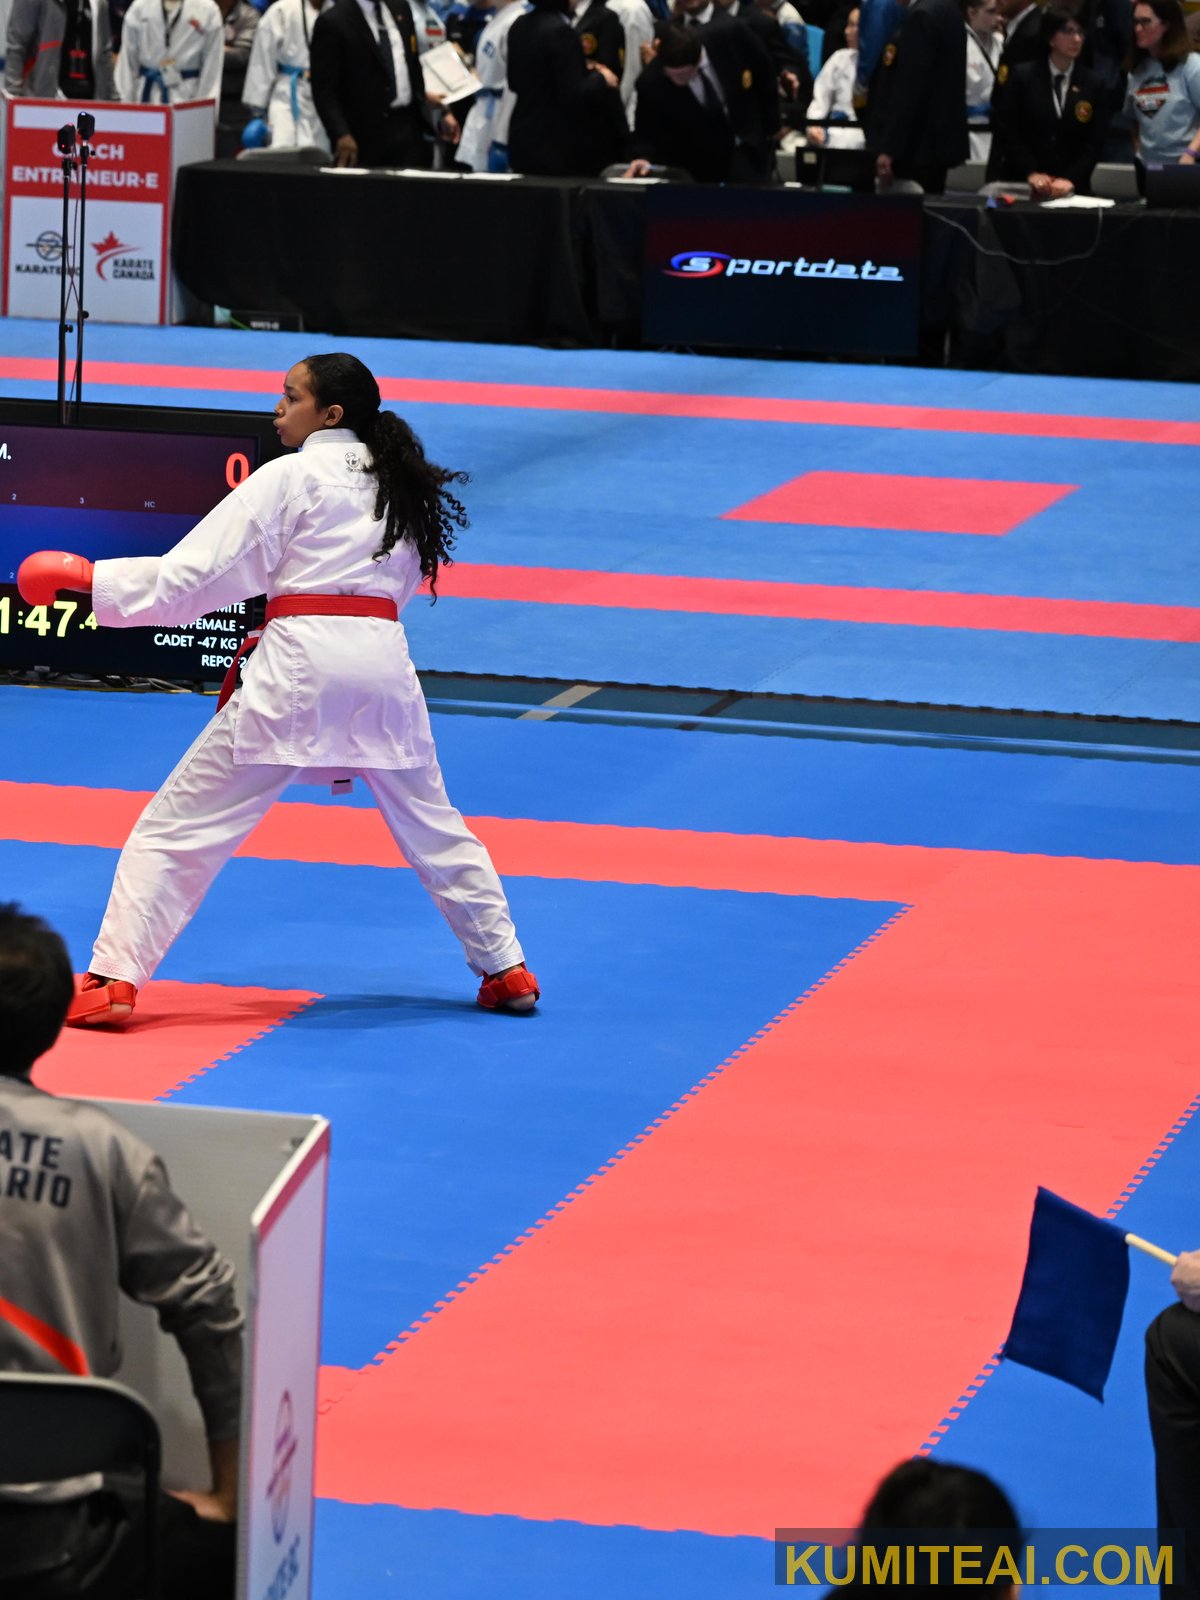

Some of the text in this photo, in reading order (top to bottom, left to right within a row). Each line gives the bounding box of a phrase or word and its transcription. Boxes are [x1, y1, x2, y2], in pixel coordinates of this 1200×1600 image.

[113, 258, 154, 270] KARATE
[113, 269, 155, 281] CANADA
[225, 453, 250, 490] 0
[9, 571, 15, 579] 2
[153, 633, 194, 647] CADET
[197, 636, 217, 648] -47
[220, 638, 237, 650] KG
